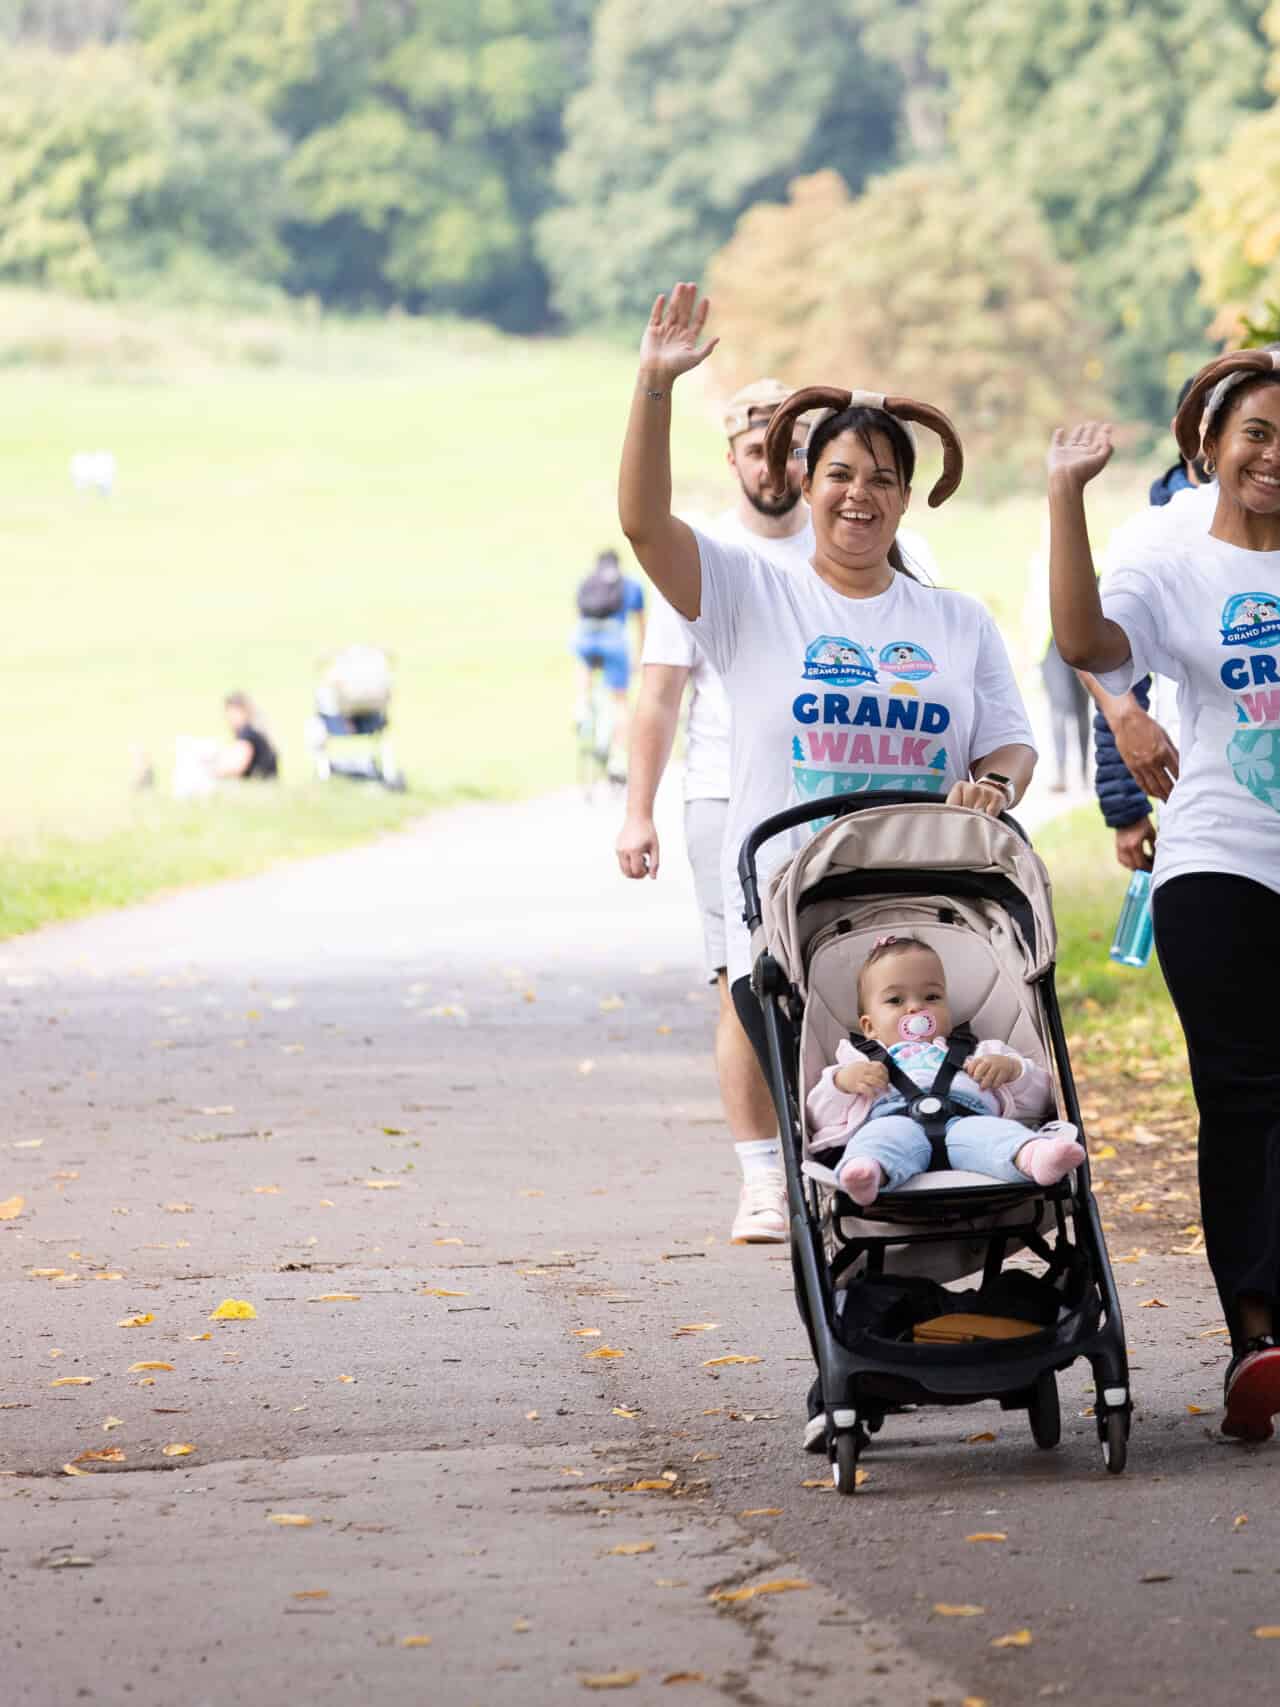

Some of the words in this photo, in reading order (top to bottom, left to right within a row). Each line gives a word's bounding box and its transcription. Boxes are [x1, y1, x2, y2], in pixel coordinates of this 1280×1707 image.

[1227, 628, 1260, 641] GRAND
[792, 693, 950, 734] GRAND
[807, 731, 932, 766] WALK
